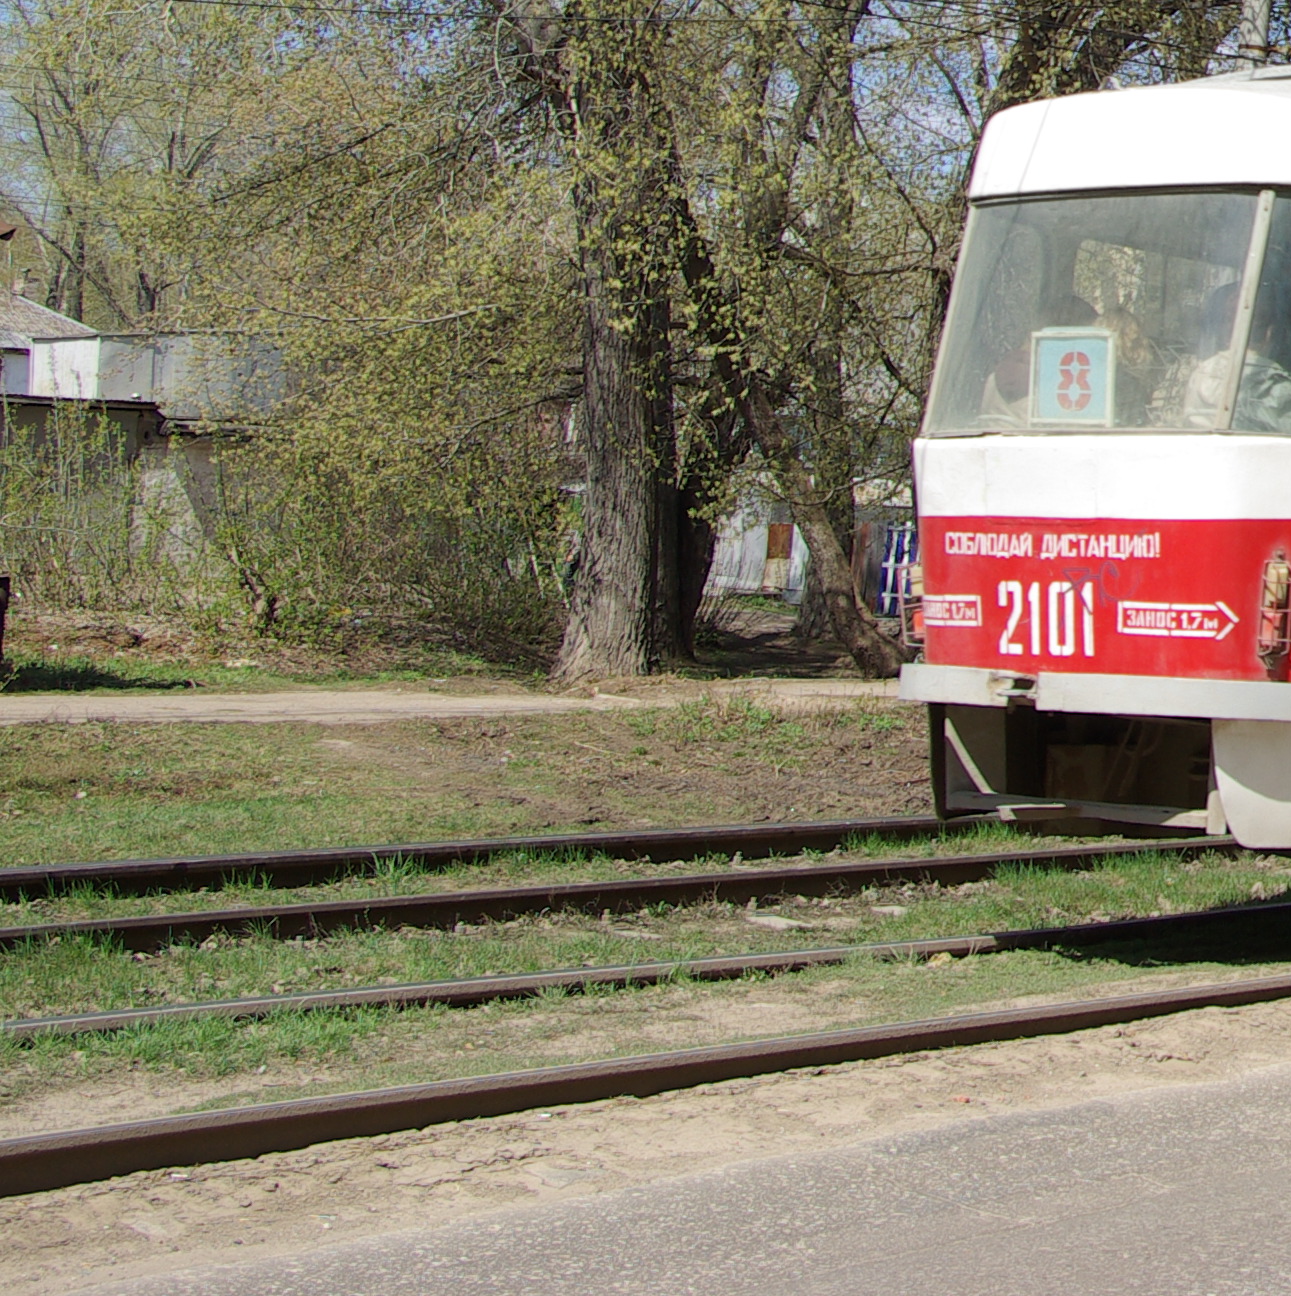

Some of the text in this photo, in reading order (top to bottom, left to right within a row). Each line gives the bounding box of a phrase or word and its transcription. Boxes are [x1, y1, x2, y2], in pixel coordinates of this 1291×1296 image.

[1057, 351, 1092, 411] 8
[945, 532, 1161, 560] СОБЛЮДАЙ ДИСТАНЦИЮ!
[998, 580, 1095, 657] 2101
[1126, 609, 1177, 629] ЗАНОС
